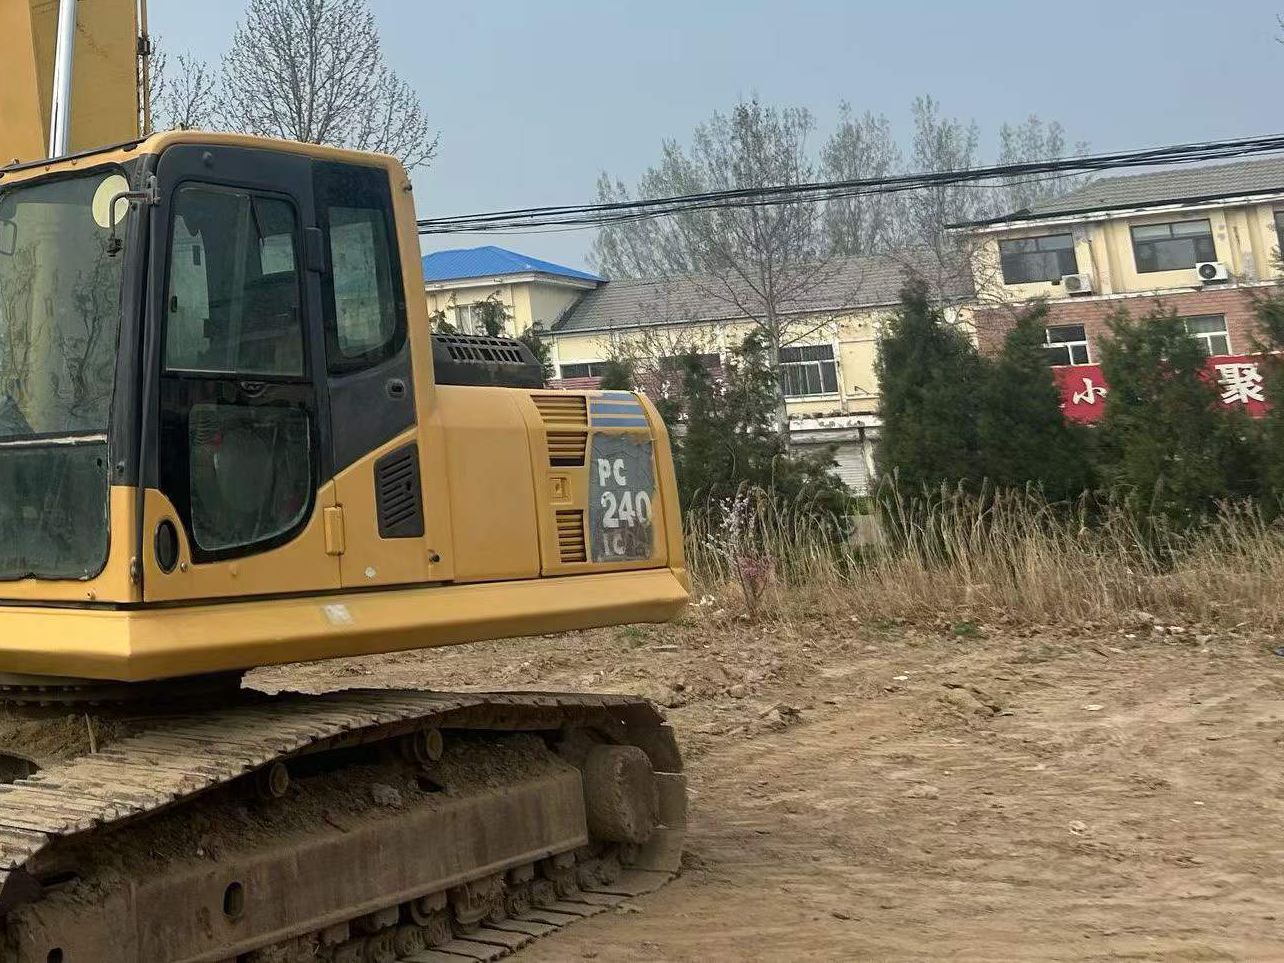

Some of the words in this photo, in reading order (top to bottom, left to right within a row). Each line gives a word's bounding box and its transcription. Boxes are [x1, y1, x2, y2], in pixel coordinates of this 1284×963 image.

[1072, 377, 1107, 405] 小
[1215, 363, 1266, 404] 聚
[597, 458, 627, 487] PC
[600, 490, 653, 529] 240
